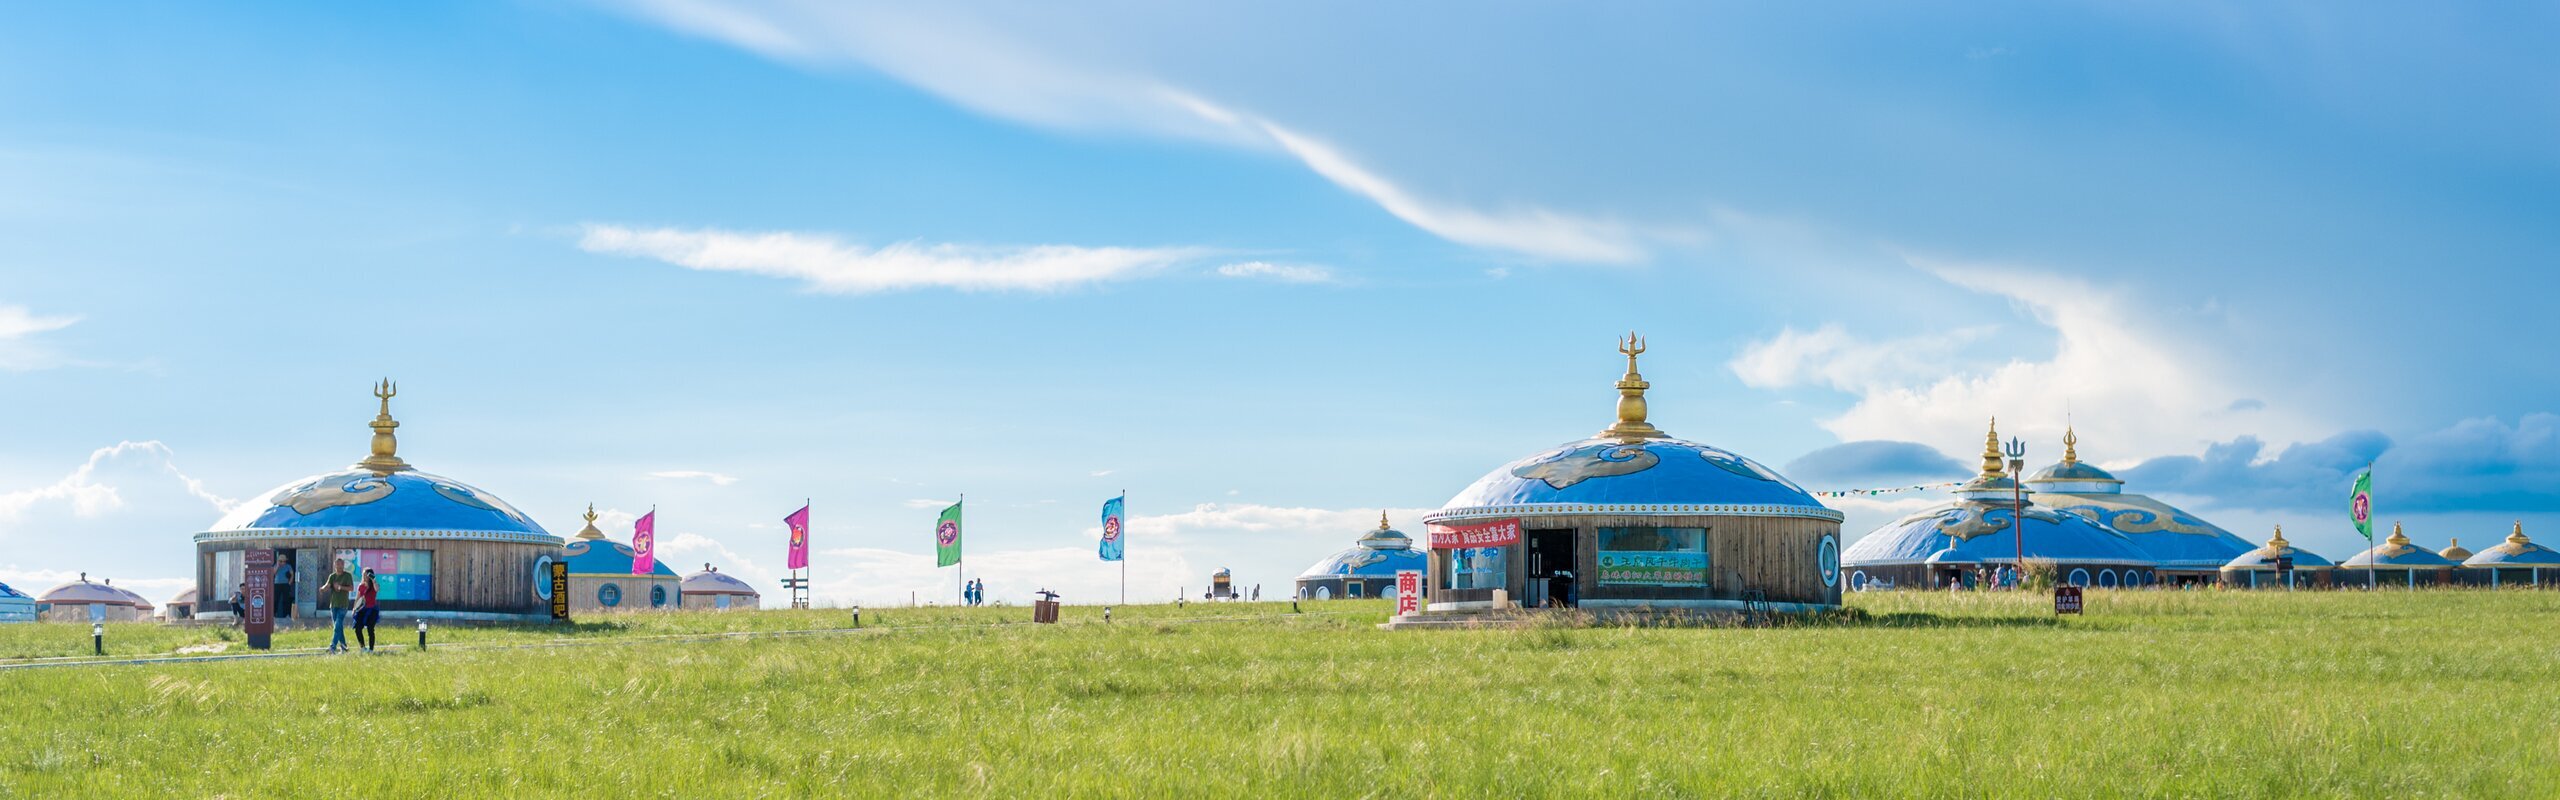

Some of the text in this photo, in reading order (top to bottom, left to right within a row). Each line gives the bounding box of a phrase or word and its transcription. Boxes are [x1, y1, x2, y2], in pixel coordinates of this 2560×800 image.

[553, 564, 566, 617] 蒙古酒吧
[1398, 572, 1417, 615] 商店
